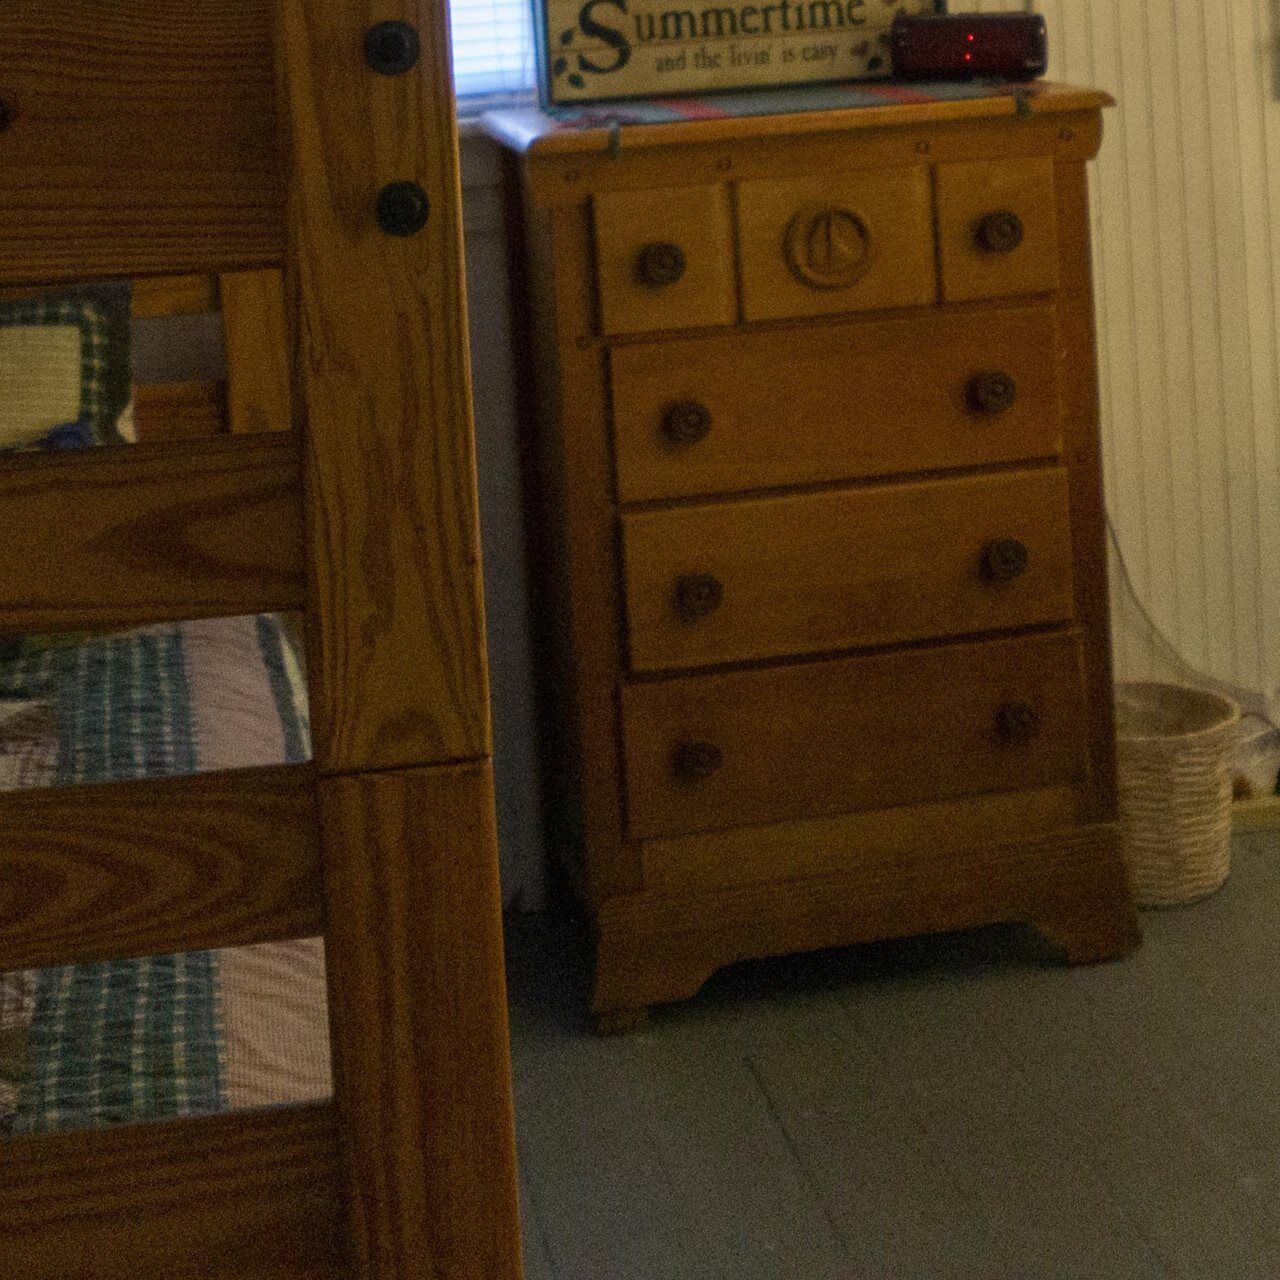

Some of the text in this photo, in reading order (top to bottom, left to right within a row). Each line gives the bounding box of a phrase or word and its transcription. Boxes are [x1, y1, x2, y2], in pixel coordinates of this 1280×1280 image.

[655, 48, 686, 72] and
[693, 45, 721, 69] the
[802, 43, 838, 67] easy
